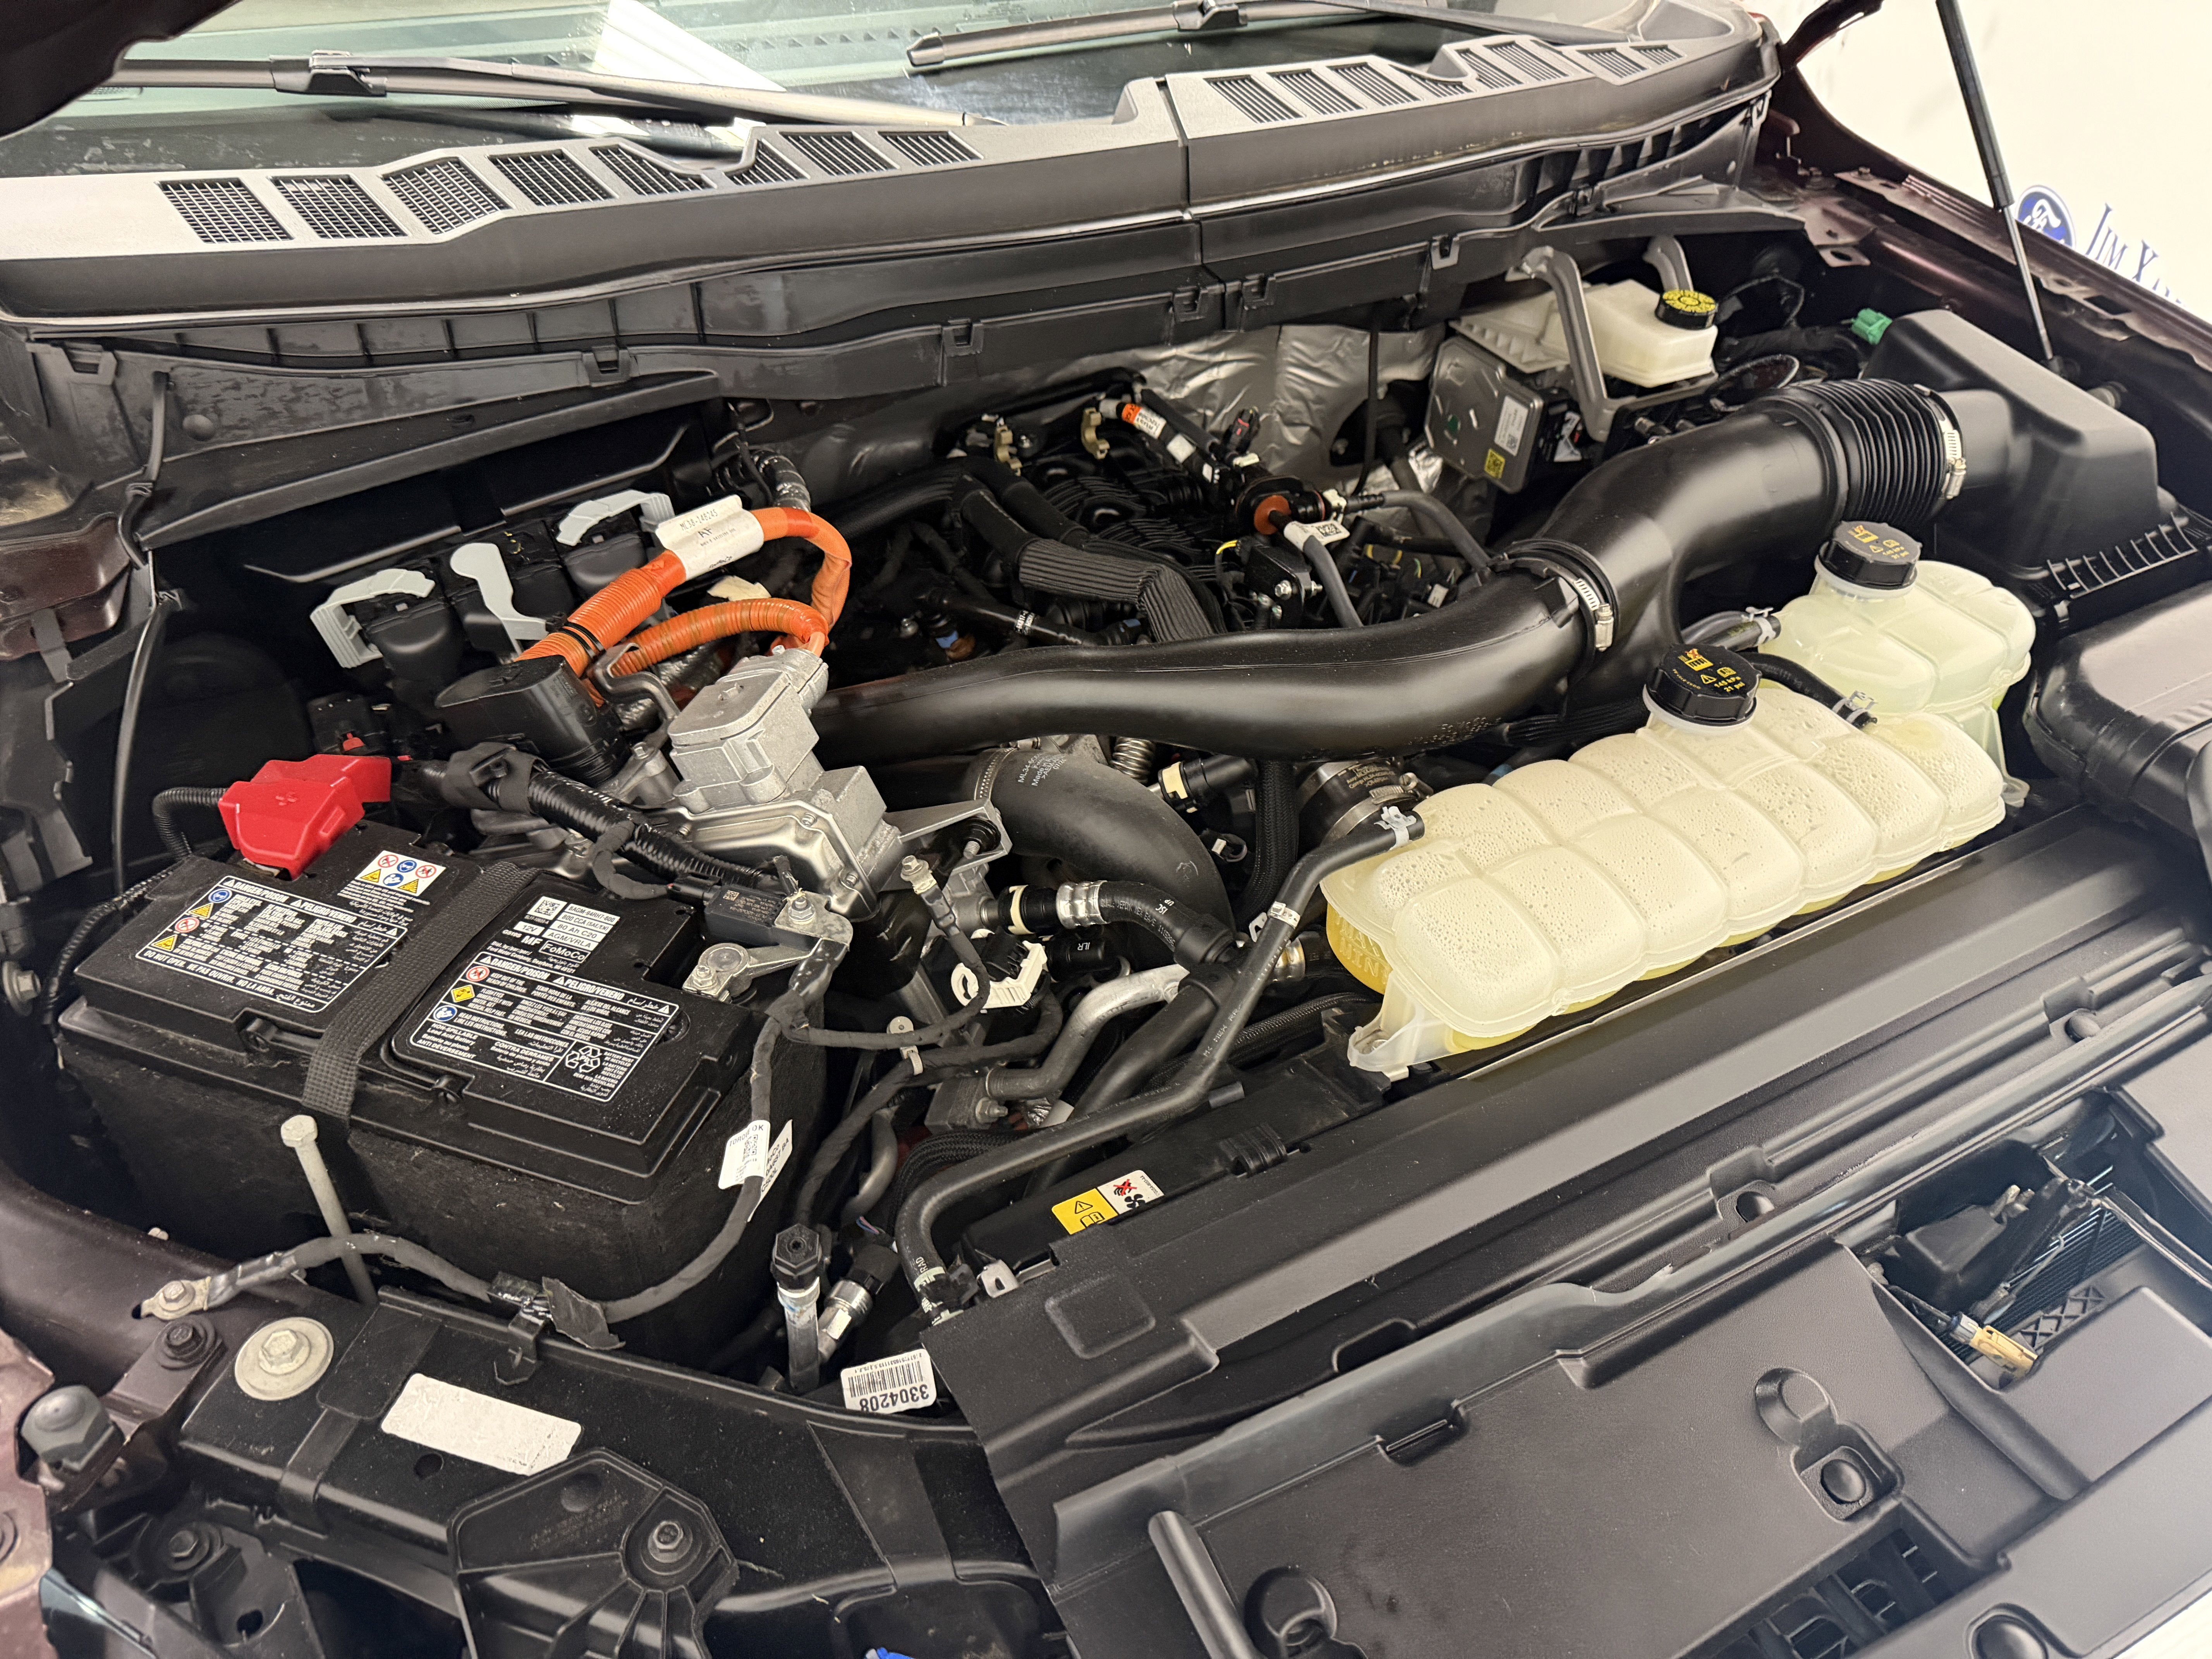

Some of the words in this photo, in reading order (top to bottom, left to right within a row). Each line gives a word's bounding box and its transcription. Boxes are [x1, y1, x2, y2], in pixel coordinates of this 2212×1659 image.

[231, 882, 290, 903] DANGER/POISON
[298, 902, 359, 923] PELIGRO/VENENO
[567, 906, 617, 922] BAGM-94RH7-800
[580, 930, 598, 938] C20
[586, 921, 610, 931] (SAE/EN)
[520, 935, 543, 946] MF
[546, 932, 593, 948] AGM/VRLA
[541, 943, 587, 960] FoMoCo
[152, 953, 170, 962] NOT
[165, 957, 189, 968] OPEN.
[489, 958, 551, 980] DANGER/POISON
[194, 966, 211, 975] PAS
[207, 970, 238, 983] OUVRIR.
[235, 979, 249, 987] NO
[253, 985, 278, 996] ABRA.
[530, 989, 550, 999] PORTÉE
[563, 978, 626, 1001] PELIGRO/VENENO
[610, 1005, 631, 1015] ALCANCE
[470, 1015, 506, 1029] INSTRUCTIONS.
[472, 1022, 510, 1037] INSTRUCTIONS.
[426, 1027, 442, 1036] Lead
[452, 1036, 476, 1046] Battery
[430, 1023, 479, 1040] NON-SPILLABLE
[416, 1039, 433, 1047] ANTI
[431, 1042, 477, 1060] DÉVERSEMENT
[421, 1033, 445, 1044] Batterie
[450, 1042, 471, 1052] plomb
[493, 1041, 522, 1053] CONTRA
[519, 1048, 555, 1062] DERRAMES
[578, 1055, 592, 1063] Pb
[915, 1257, 929, 1273] RAD
[859, 1384, 929, 1412] 3304208
